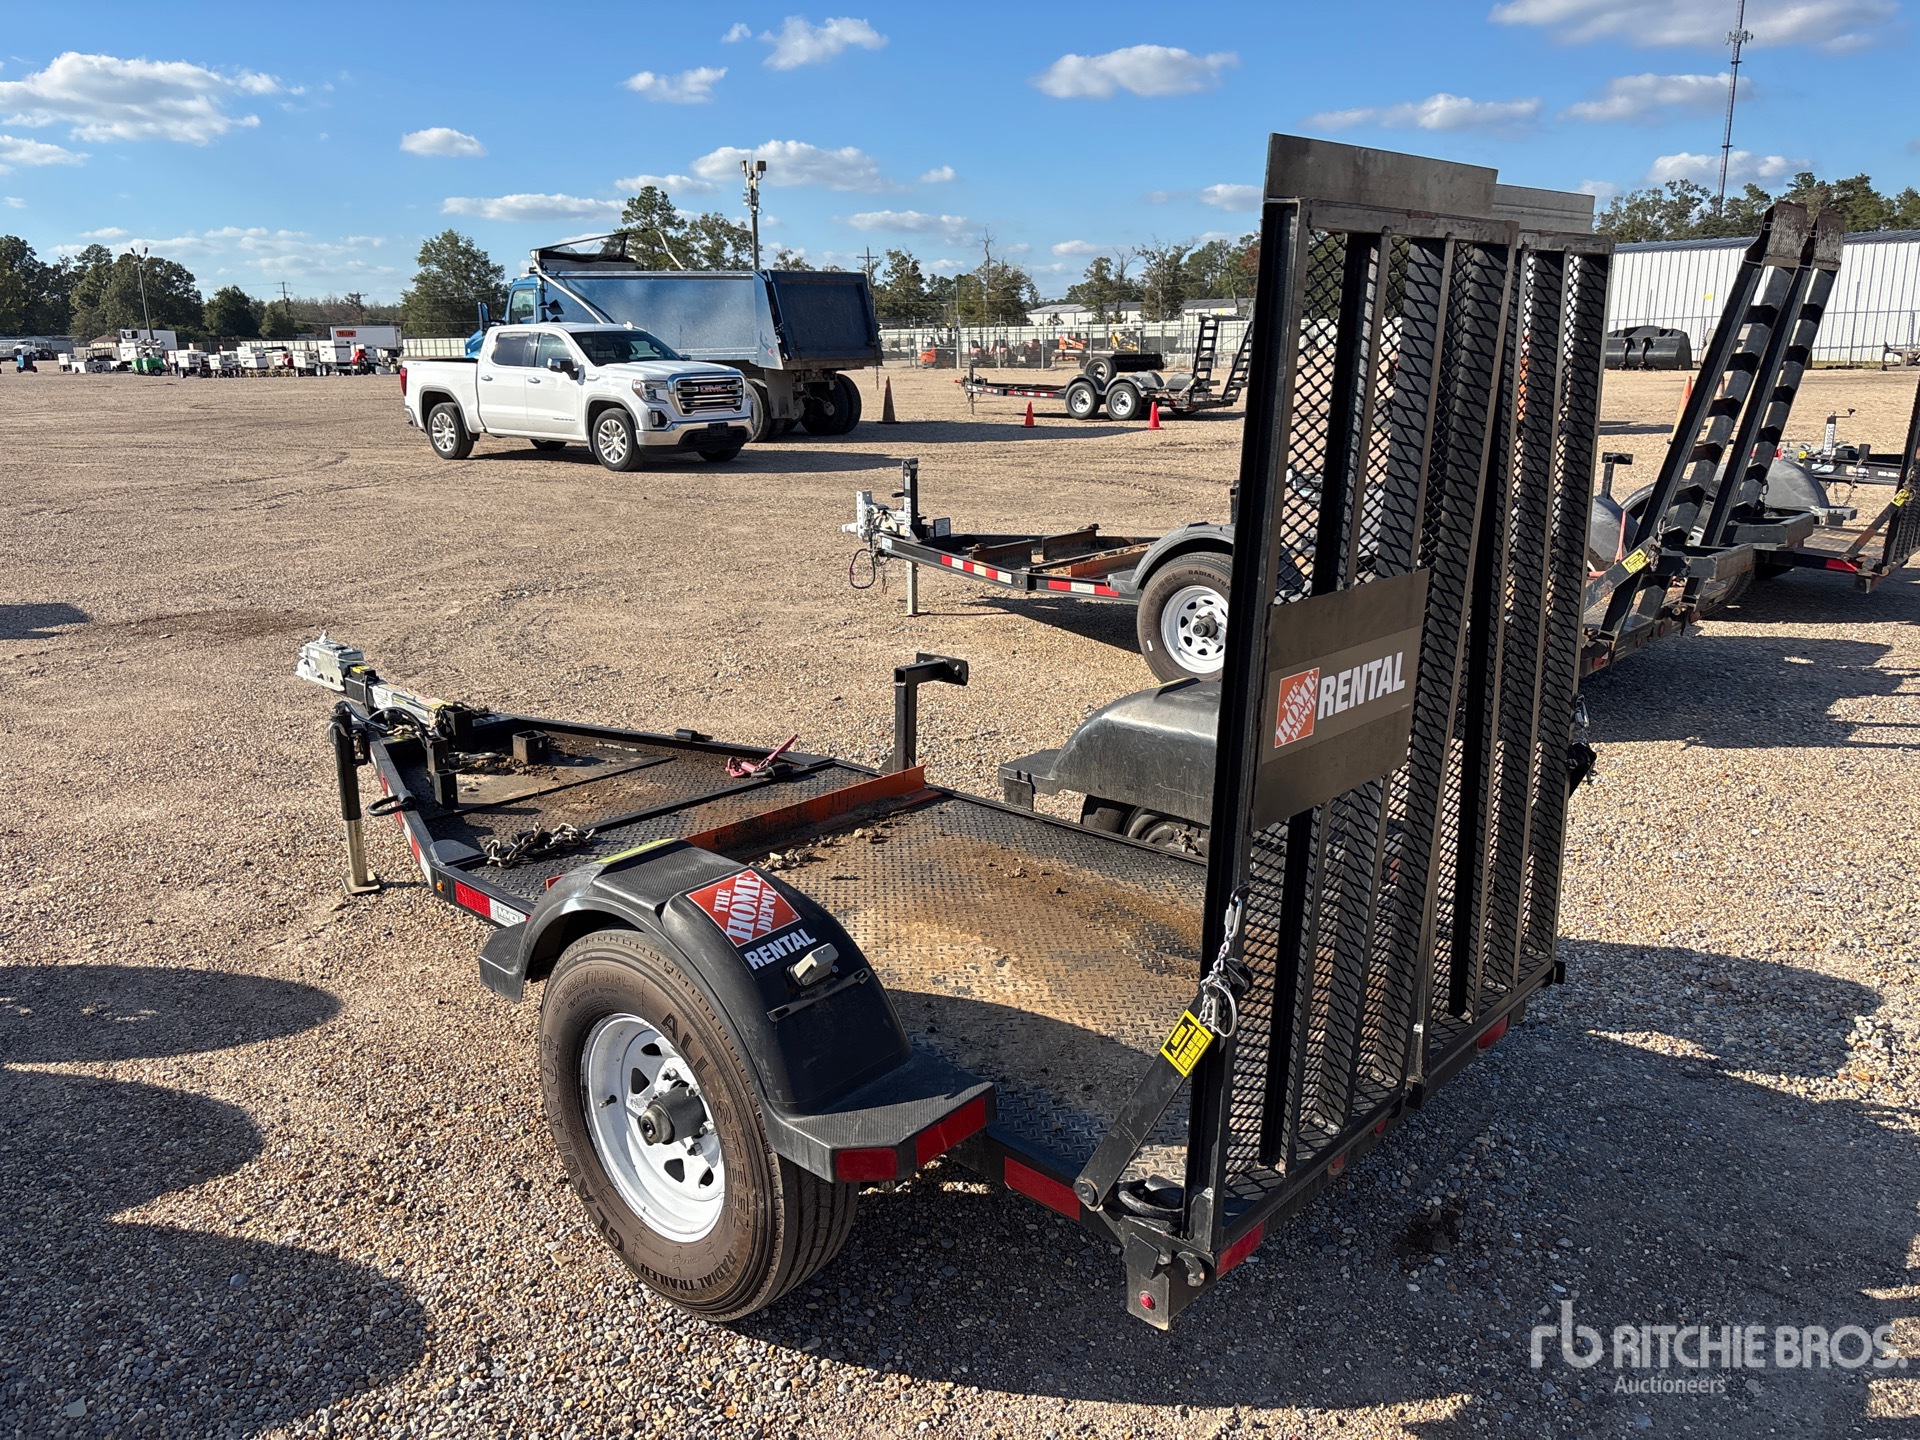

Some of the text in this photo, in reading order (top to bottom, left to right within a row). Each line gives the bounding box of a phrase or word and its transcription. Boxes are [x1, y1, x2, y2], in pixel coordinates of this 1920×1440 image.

[700, 384, 727, 393] GMC
[1188, 569, 1217, 581] RADIAL
[1282, 681, 1300, 710] THE
[1317, 652, 1406, 720] RENTAL
[1276, 670, 1318, 745] HOME
[1290, 693, 1316, 740] DEPOT
[713, 888, 732, 913] THE
[726, 872, 762, 942] HOME
[756, 886, 778, 932] DEPOT
[744, 928, 817, 970] RENTAL
[640, 1249, 737, 1291] RADIAL TRAILER
